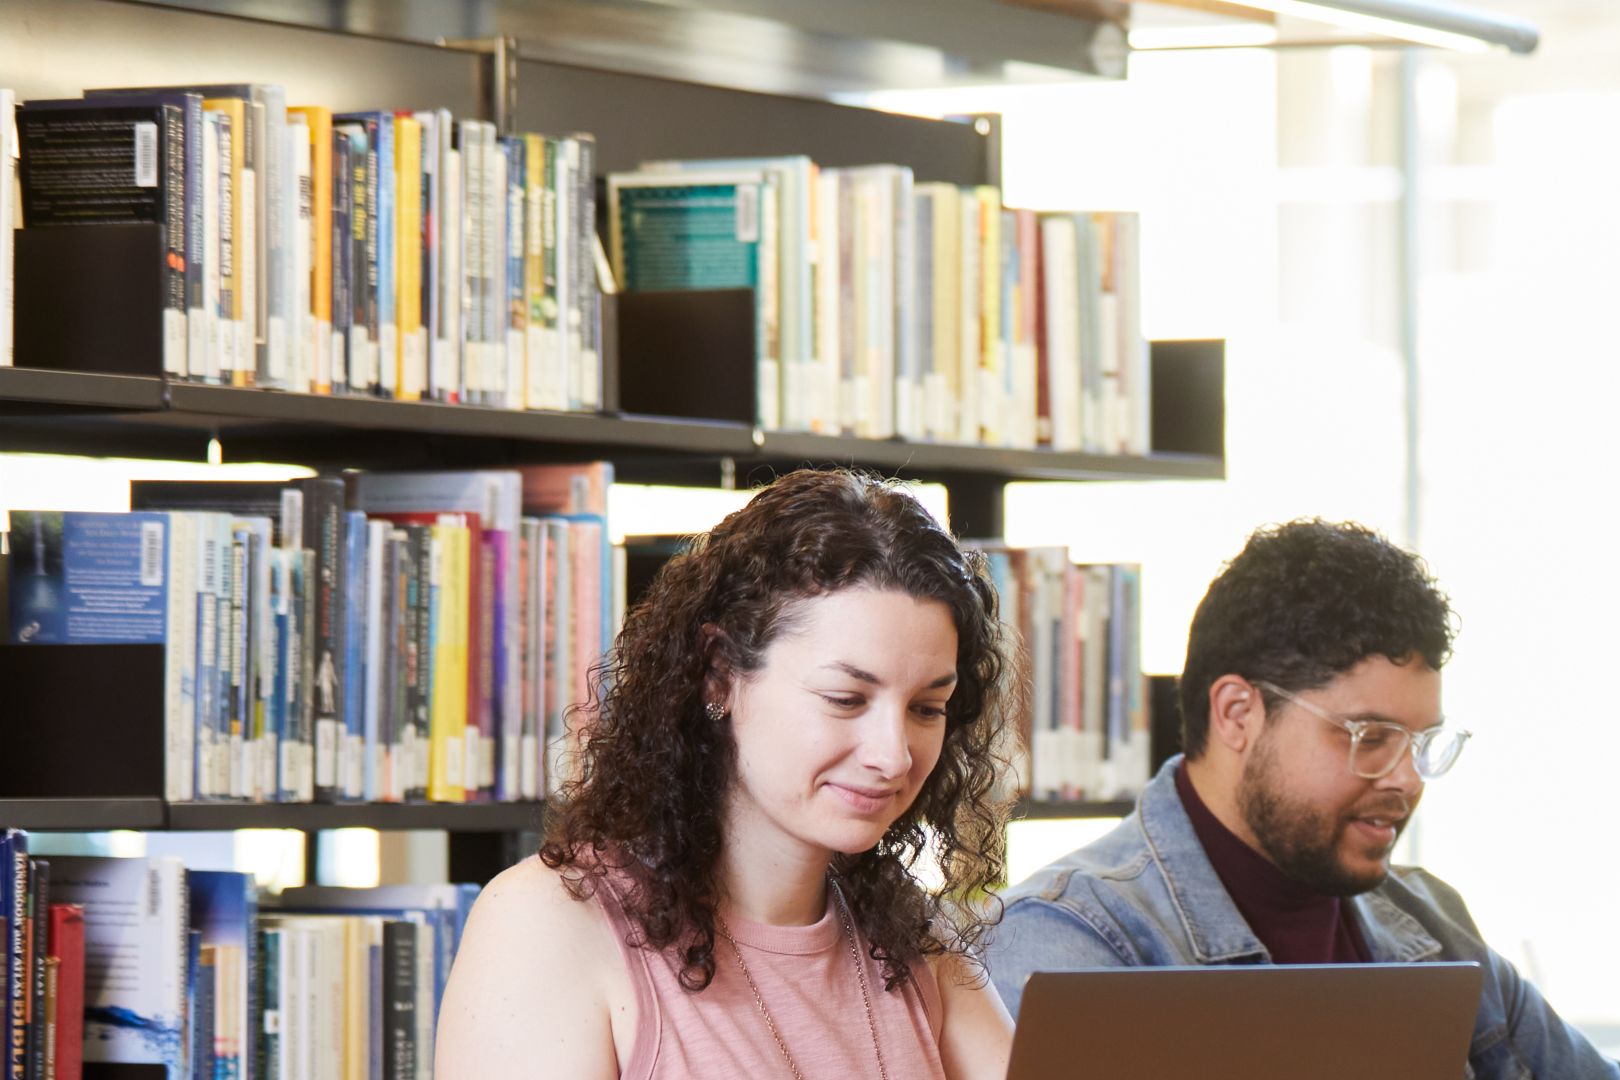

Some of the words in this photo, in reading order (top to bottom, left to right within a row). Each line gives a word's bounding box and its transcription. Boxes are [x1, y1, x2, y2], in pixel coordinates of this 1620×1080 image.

[222, 132, 232, 173] SEVEN
[222, 176, 232, 240] GLORIOUS
[354, 184, 367, 204] six
[353, 207, 368, 240] days
[222, 242, 232, 276] DAYS
[15, 852, 26, 926] HANDBOOK
[38, 877, 47, 953] ZONDERVAN
[15, 929, 26, 954] and
[14, 956, 26, 997] ATLAS
[37, 958, 45, 996] ATLAS
[13, 1000, 25, 1080] BIBLE
